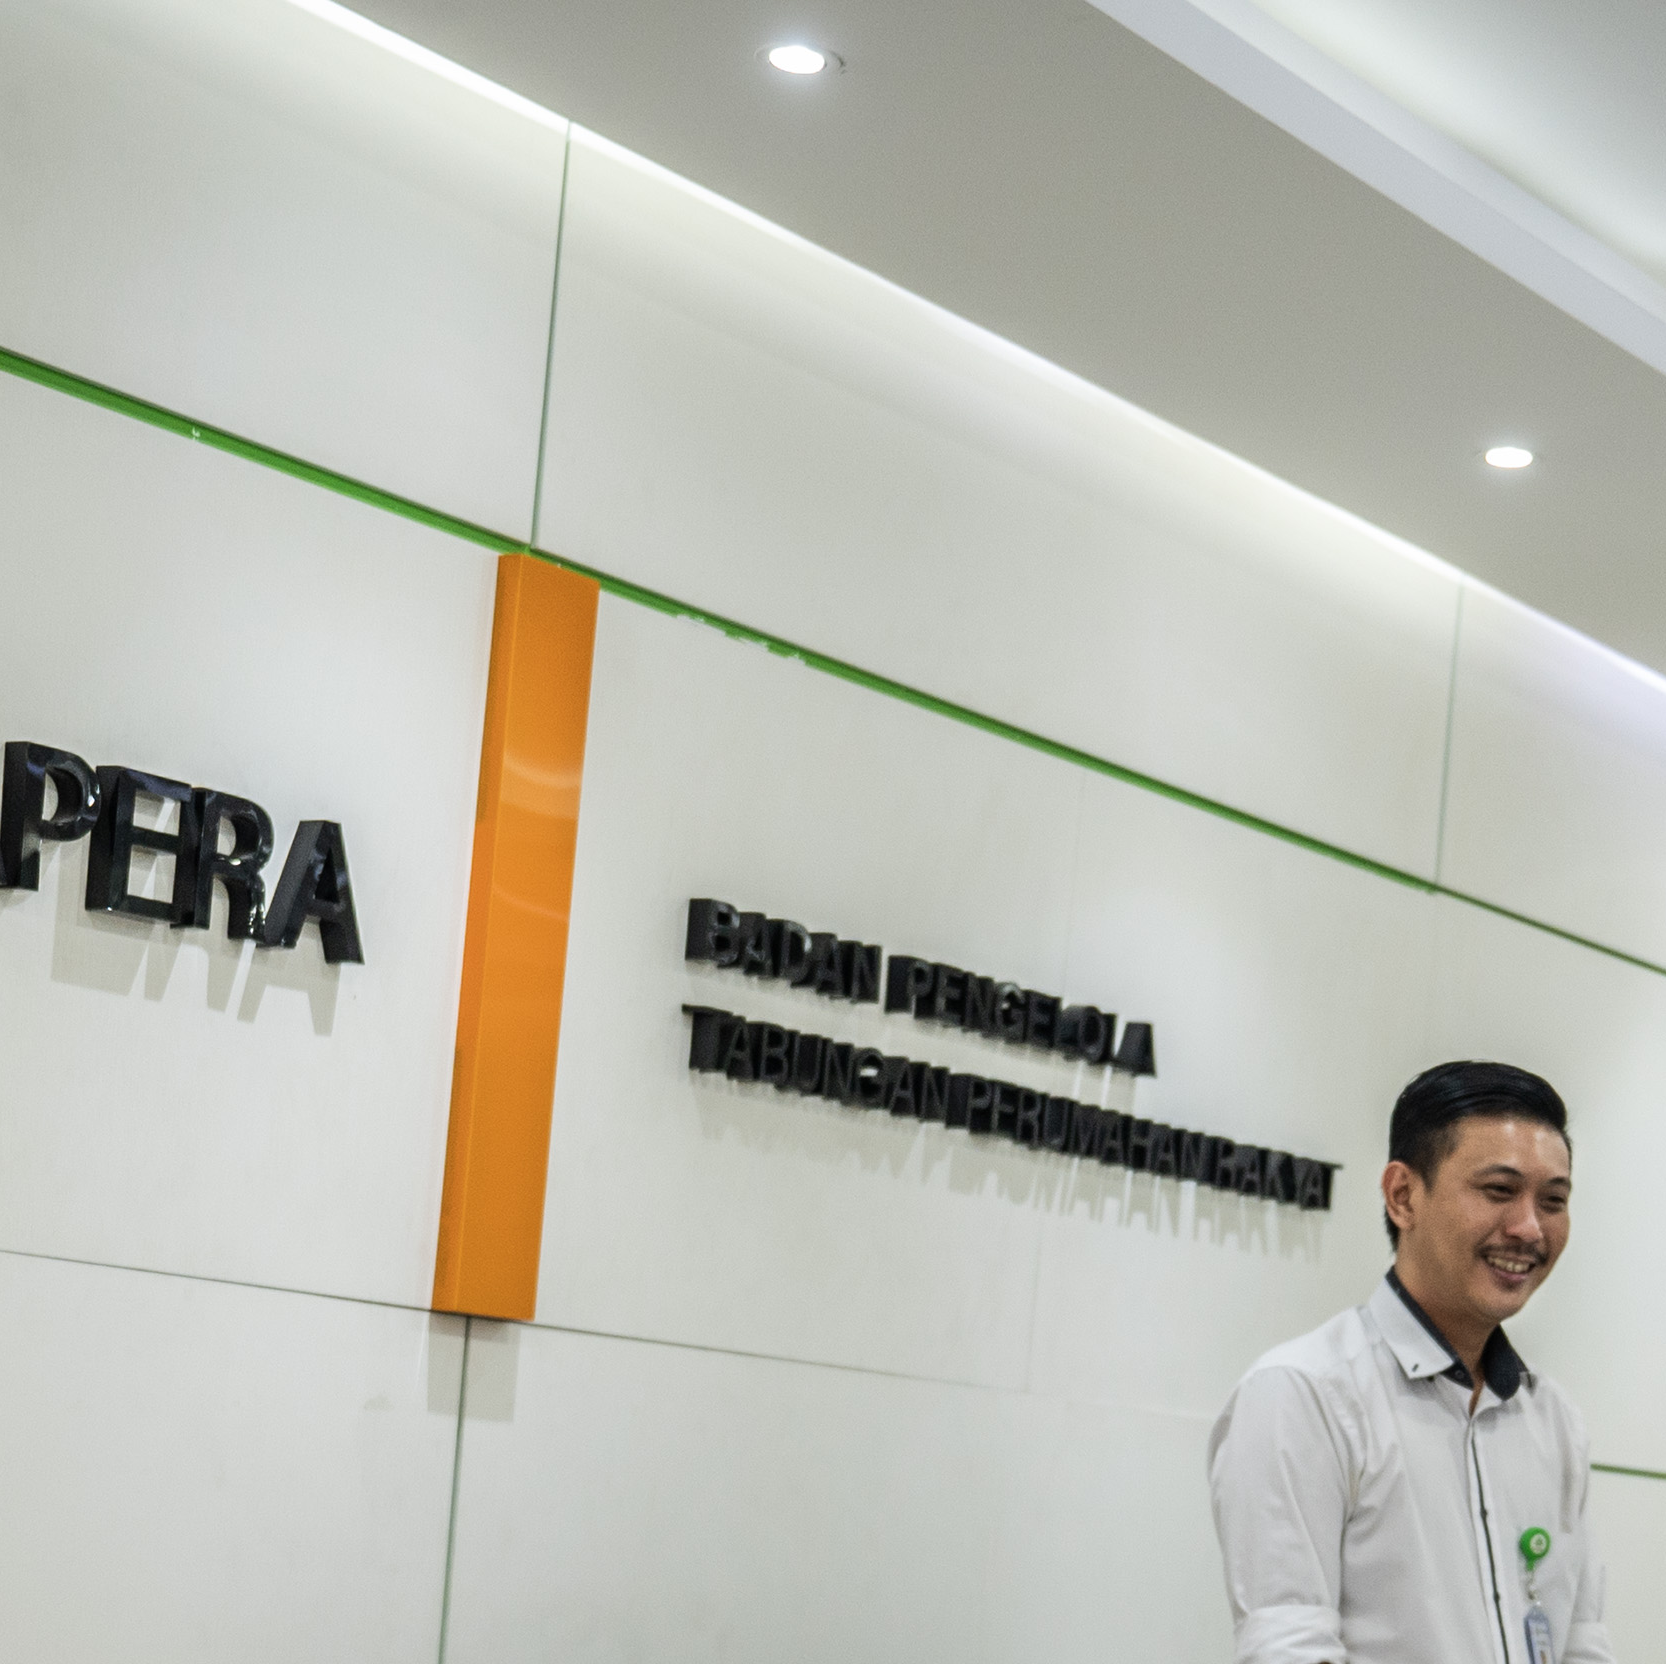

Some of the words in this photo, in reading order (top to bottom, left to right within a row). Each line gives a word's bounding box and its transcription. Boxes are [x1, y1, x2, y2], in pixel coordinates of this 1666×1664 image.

[685, 898, 882, 1004] BADAN
[682, 1004, 950, 1122] TABUNGAN
[945, 1073, 1207, 1184] PERUMAHAN
